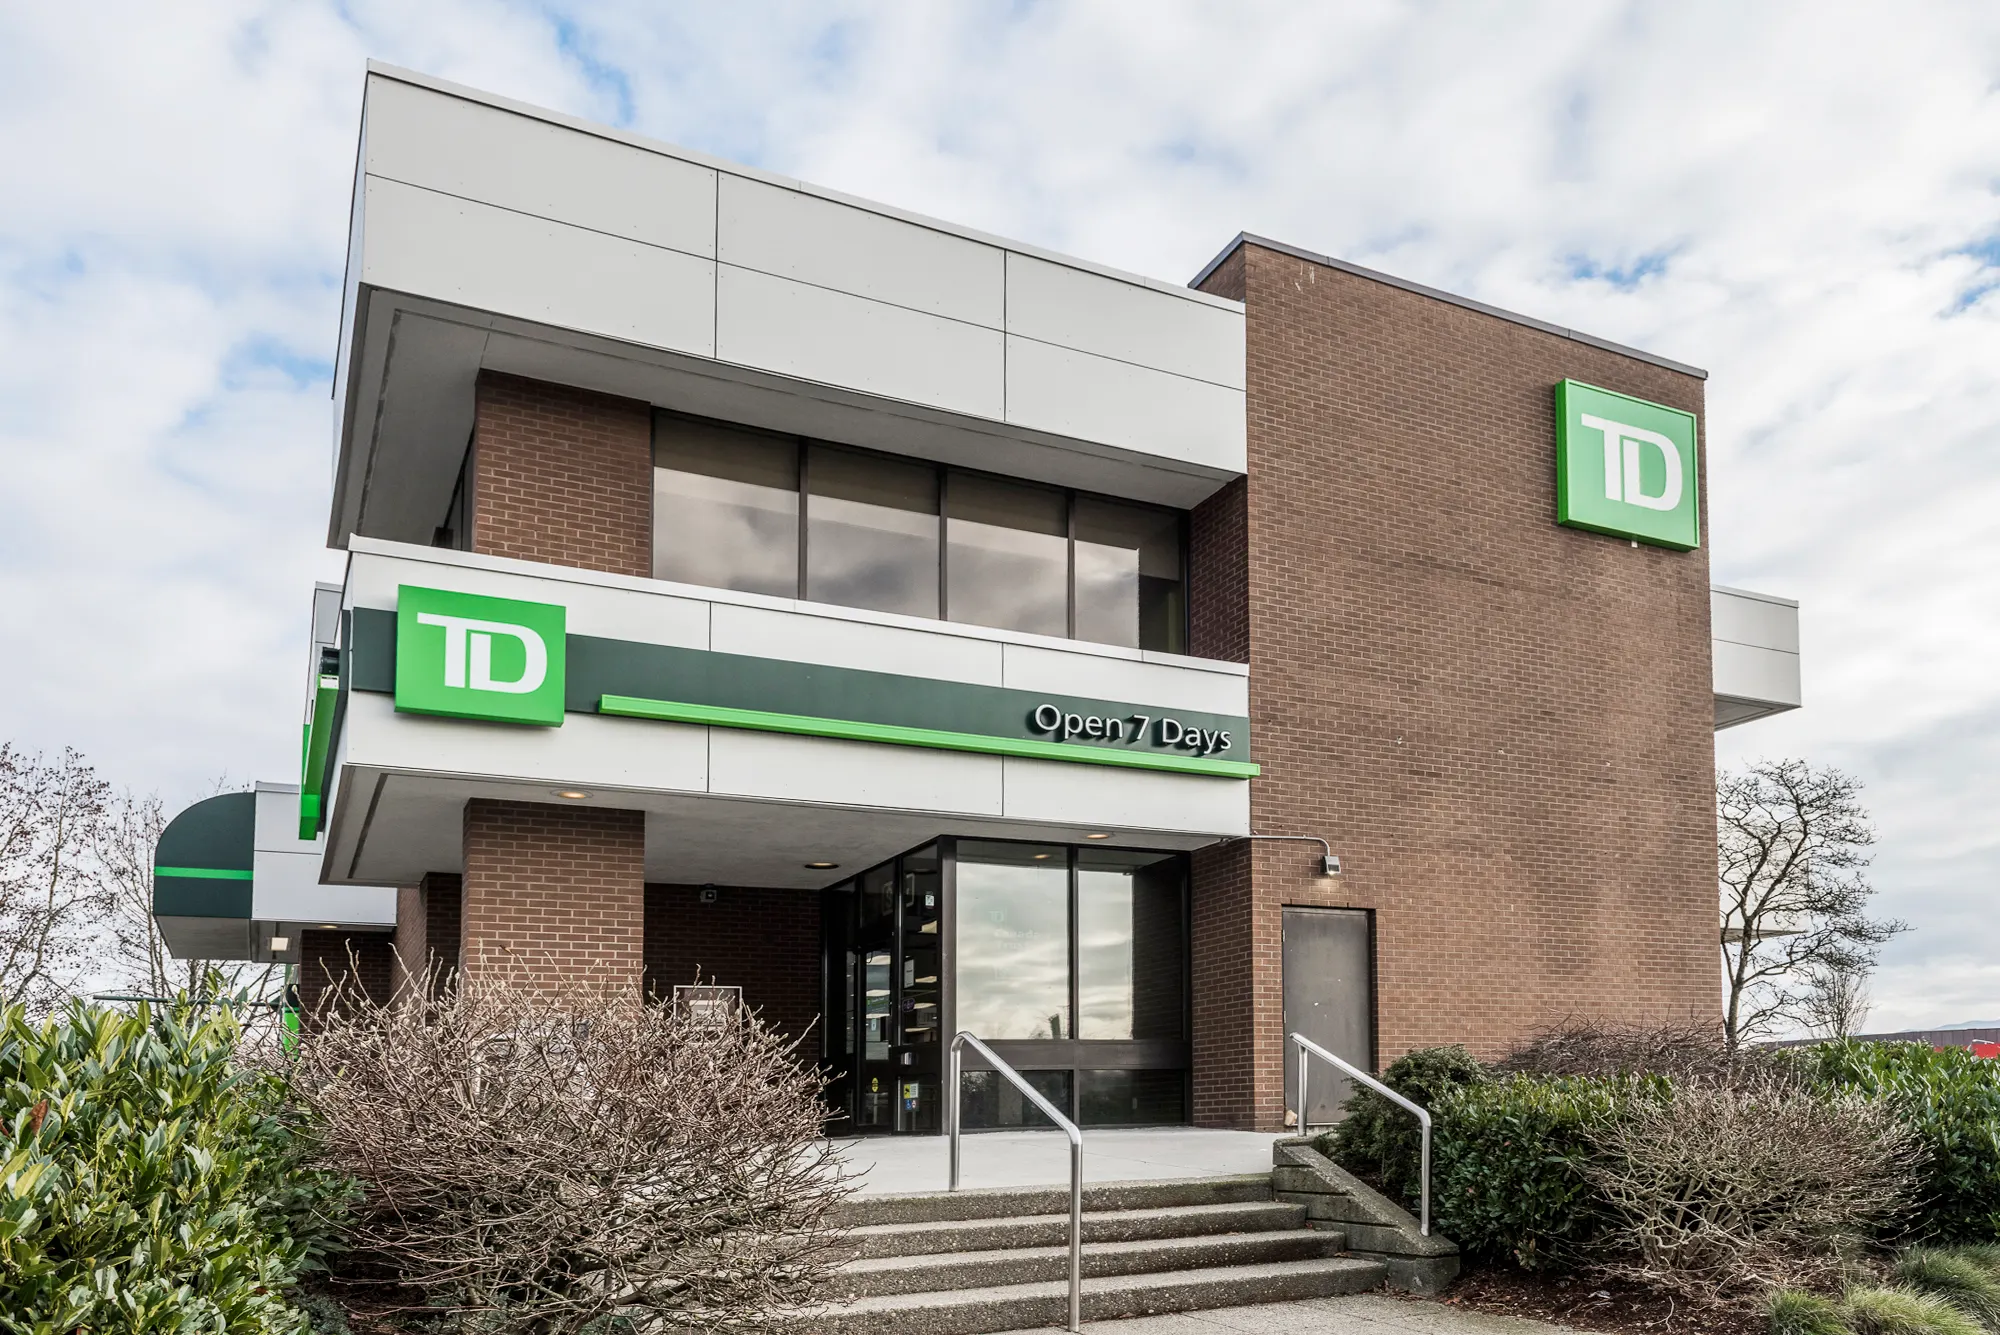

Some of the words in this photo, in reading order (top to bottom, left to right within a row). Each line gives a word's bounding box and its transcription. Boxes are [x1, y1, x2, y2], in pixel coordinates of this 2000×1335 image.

[1581, 412, 1682, 512] TD
[417, 612, 547, 694] TD
[1035, 704, 1123, 740] Open
[1133, 715, 1150, 740] 7
[1162, 719, 1232, 754] Days
